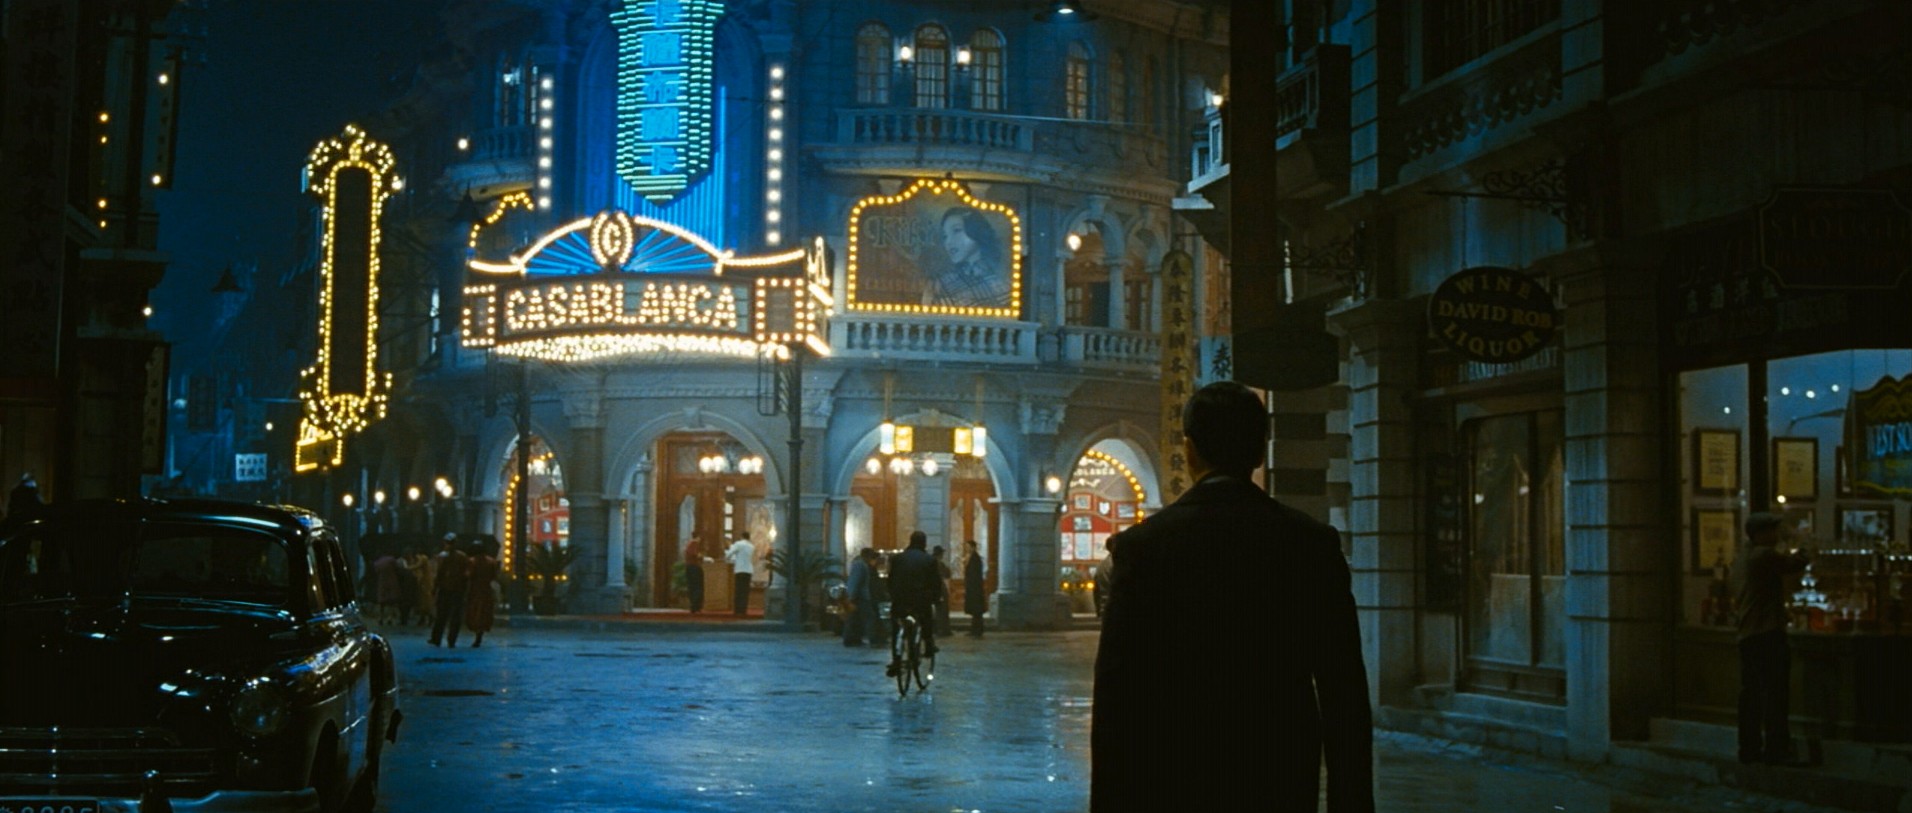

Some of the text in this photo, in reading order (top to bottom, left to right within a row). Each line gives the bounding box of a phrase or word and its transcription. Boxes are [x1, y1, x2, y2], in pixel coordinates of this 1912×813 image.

[1456, 274, 1531, 299] WINE
[506, 282, 736, 330] CASABLANCA
[1437, 299, 1508, 322] DAVID
[1443, 321, 1541, 358] LIQUOR
